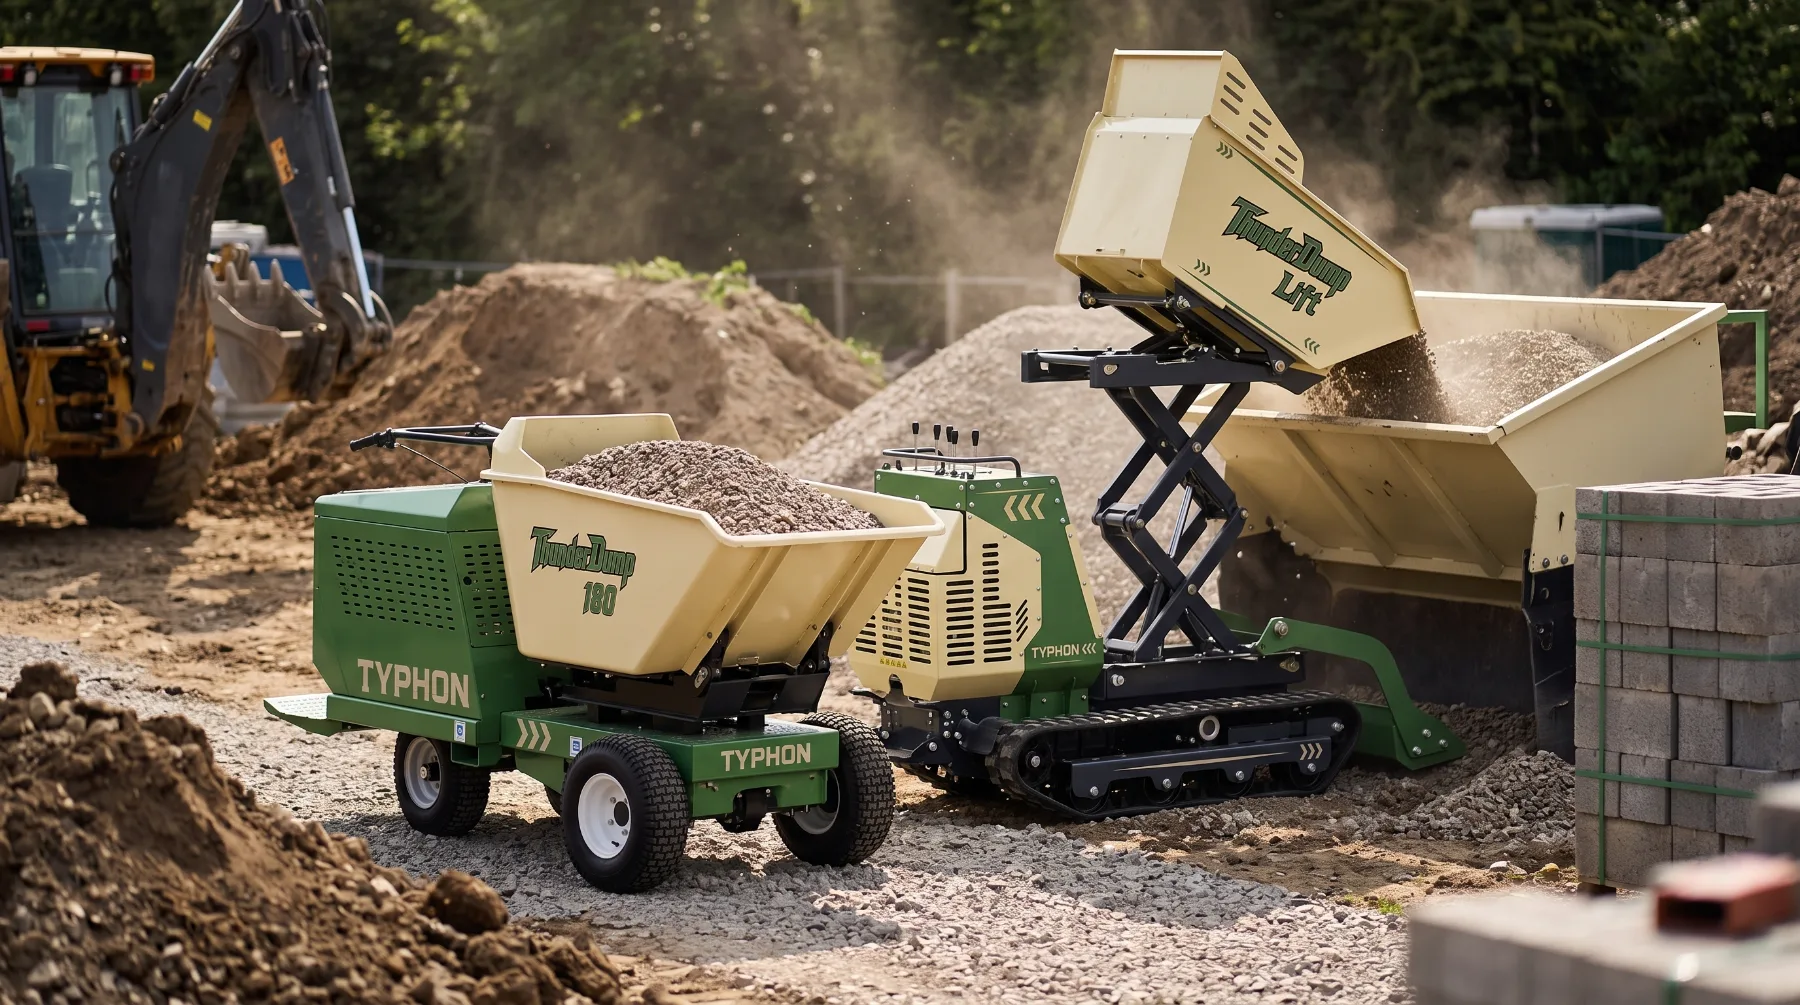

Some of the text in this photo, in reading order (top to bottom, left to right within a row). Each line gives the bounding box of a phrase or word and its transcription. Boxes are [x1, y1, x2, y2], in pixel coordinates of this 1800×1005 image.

[1221, 196, 1352, 298] ThunderDump
[1271, 270, 1323, 316] Lift
[530, 526, 636, 591] ThunderDump
[582, 581, 617, 616] 180
[1031, 644, 1079, 658] TYPHON
[357, 658, 470, 709] TYPHON
[721, 743, 811, 772] TYPHON
